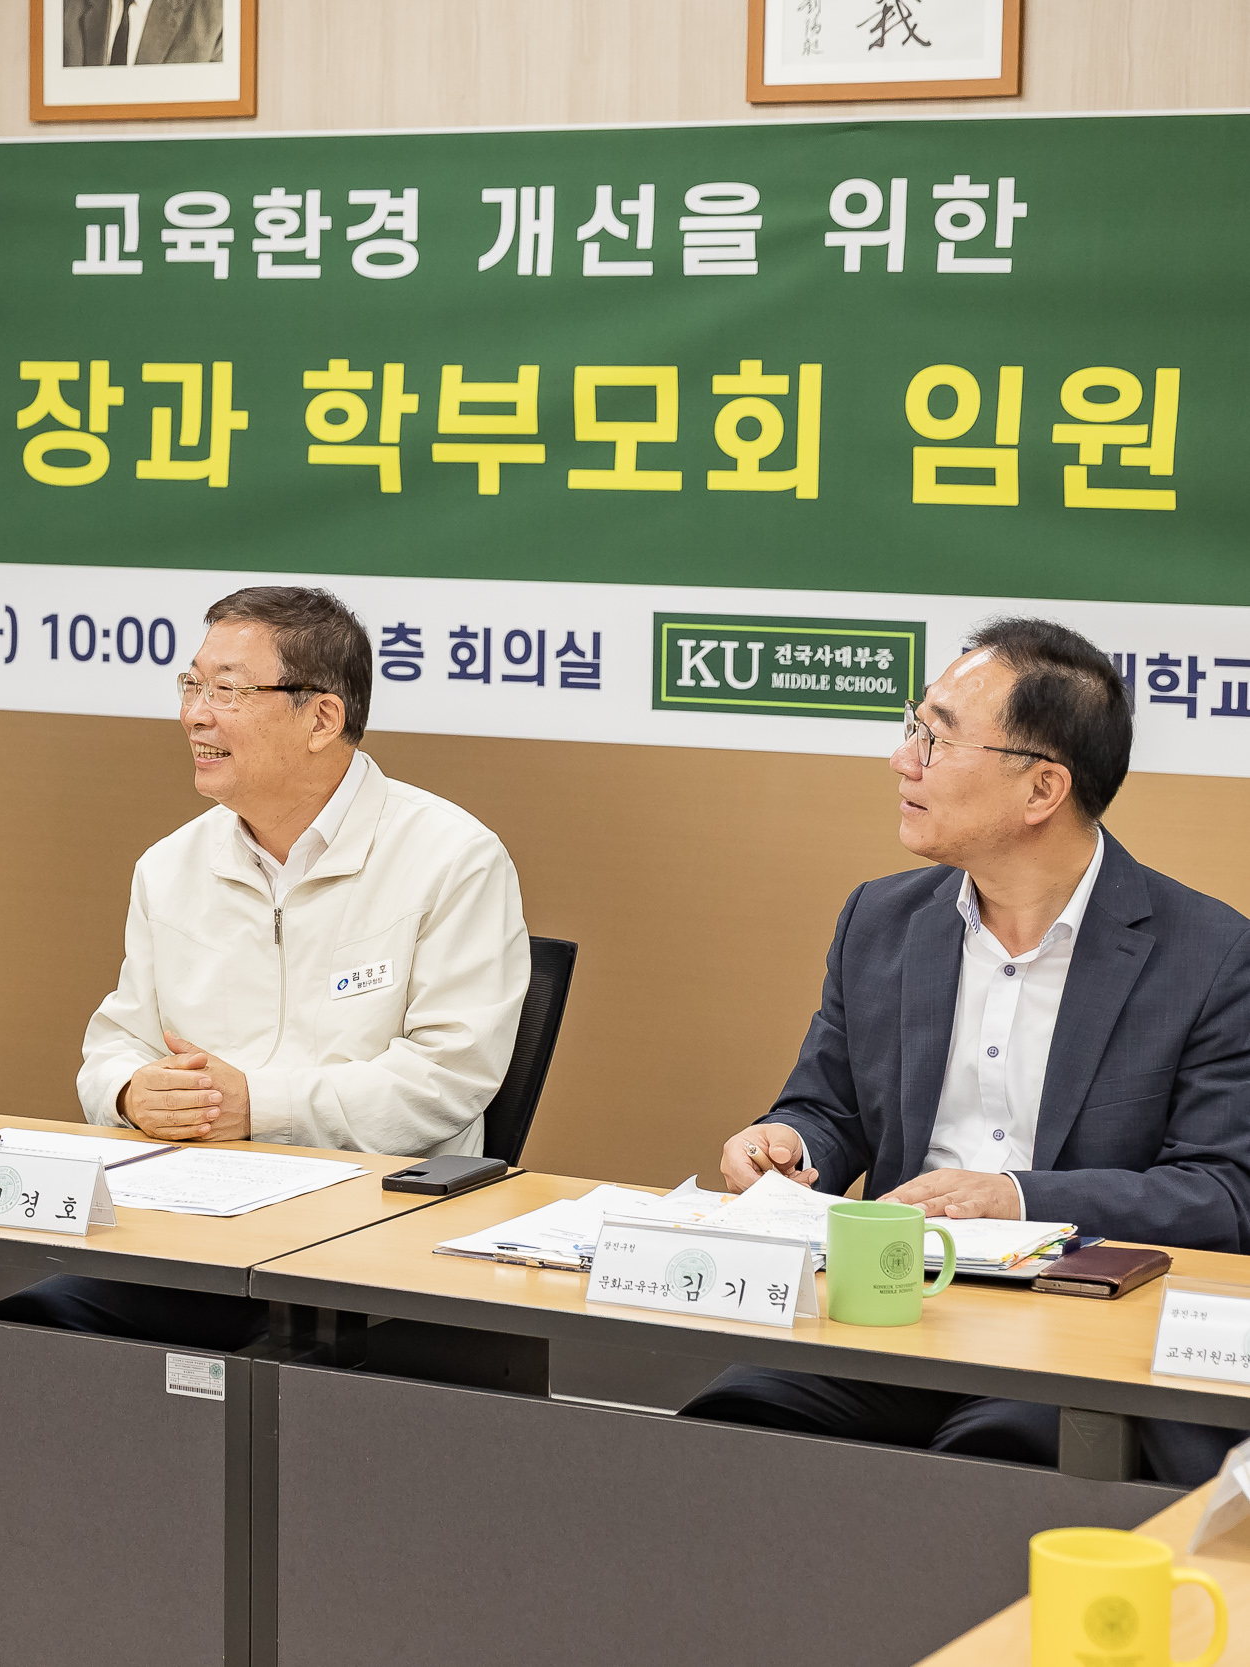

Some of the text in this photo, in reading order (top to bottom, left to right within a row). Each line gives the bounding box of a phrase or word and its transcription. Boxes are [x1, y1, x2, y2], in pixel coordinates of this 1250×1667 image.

[72, 174, 1028, 280] 교육환경 개선을 위한
[303, 358, 823, 500] 학부모회
[904, 363, 1181, 511] 임원
[42, 613, 176, 665] 10:00
[448, 624, 601, 690] 회의실
[676, 638, 765, 690] KU
[774, 643, 894, 670] 건국사대부중
[771, 672, 897, 694] MIDDLE SCHOOL
[598, 1275, 671, 1297] 문화교육국장
